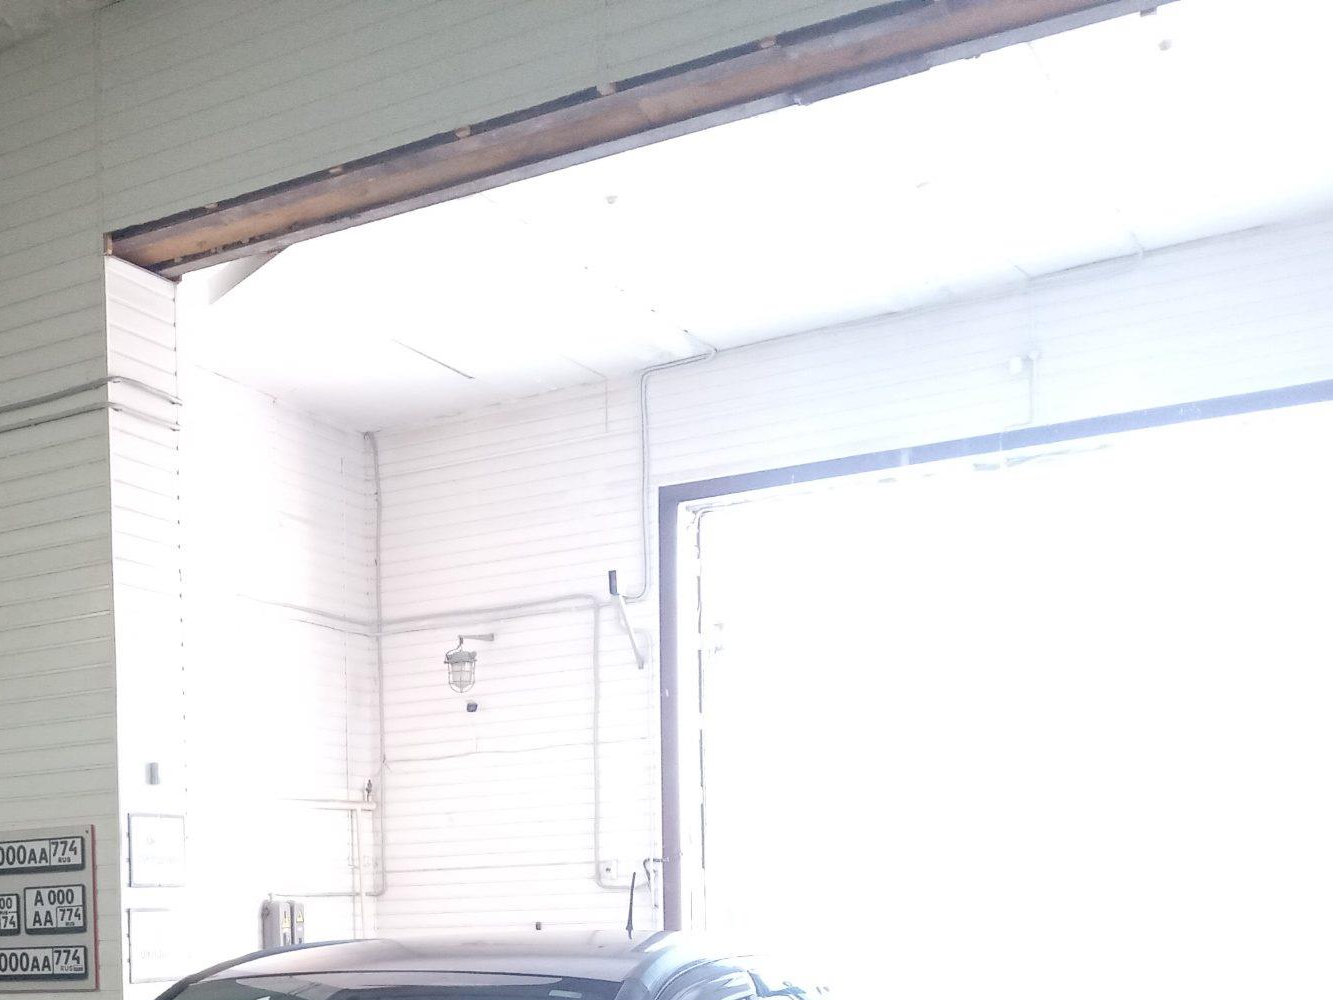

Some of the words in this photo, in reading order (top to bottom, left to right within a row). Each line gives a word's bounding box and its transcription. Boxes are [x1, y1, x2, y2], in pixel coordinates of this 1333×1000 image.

[51, 840, 77, 856] 774
[47, 888, 74, 905] 000
[2, 915, 16, 928] 74
[59, 908, 81, 922] 774
[54, 949, 80, 965] 774
